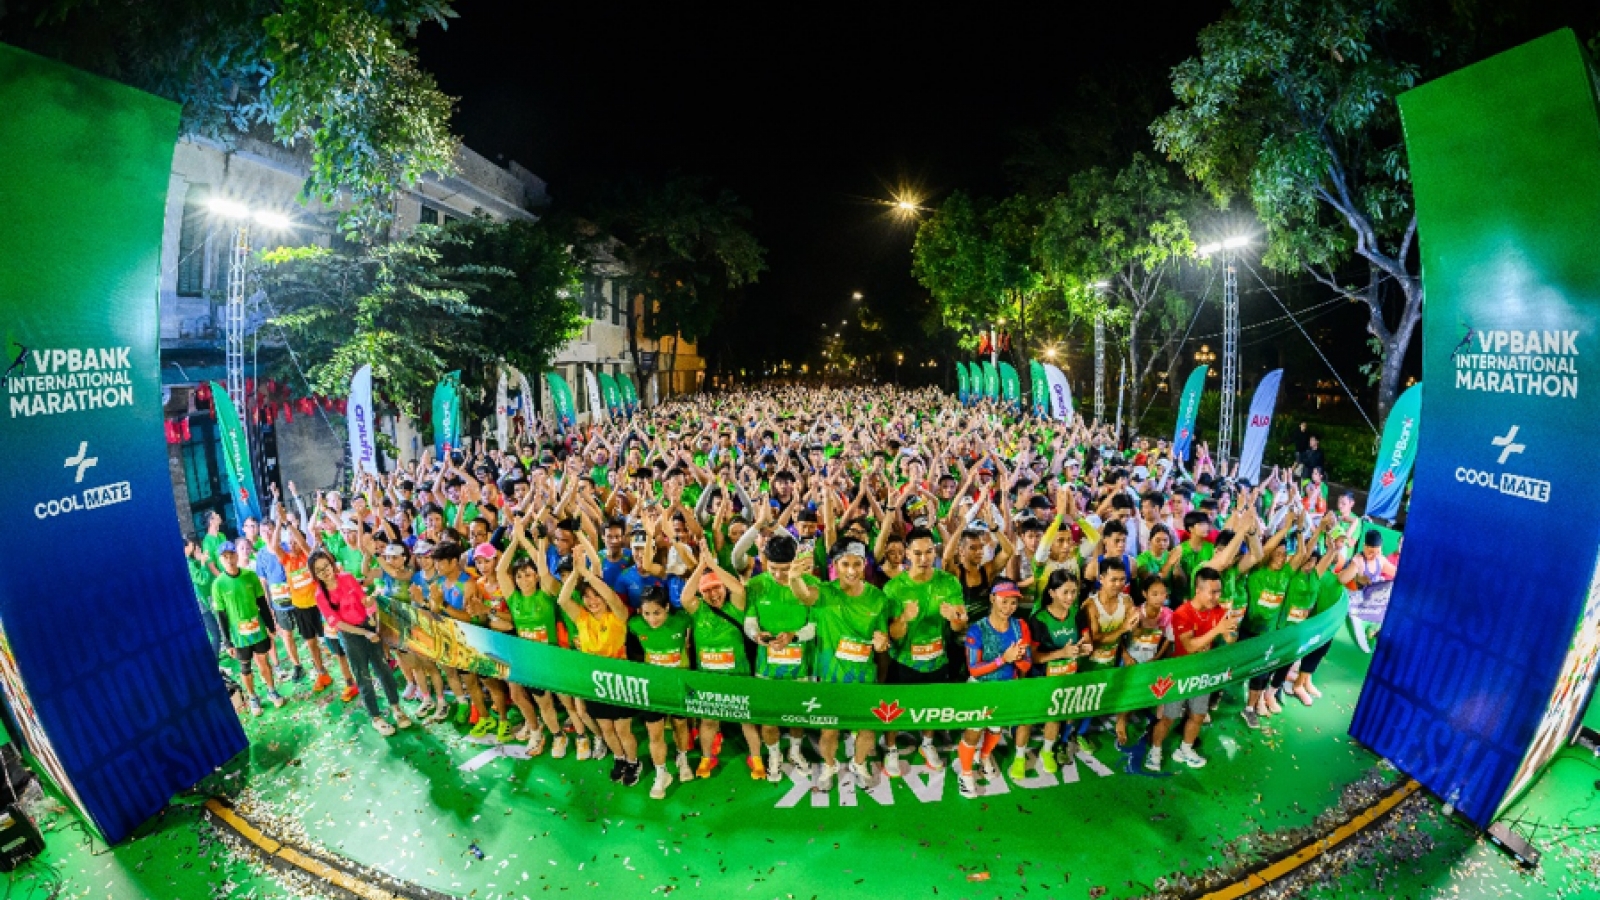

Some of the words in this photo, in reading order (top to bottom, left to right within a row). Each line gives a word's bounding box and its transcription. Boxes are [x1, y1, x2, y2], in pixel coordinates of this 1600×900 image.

[1478, 330, 1579, 355] VPBANK
[32, 346, 131, 373] VPBANK
[1455, 354, 1578, 374] INTERNATIONAL
[8, 370, 132, 394] INTERNATIONAL
[1455, 369, 1578, 399] MARATHON
[10, 385, 133, 418] MARATHON
[1391, 414, 1414, 467] VPBank
[1455, 467, 1499, 490] COOL
[1499, 473, 1551, 503] MATE
[34, 495, 84, 519] COOL
[83, 481, 132, 510] MATE
[592, 670, 649, 707] START
[1177, 668, 1232, 695] VPBank
[697, 690, 750, 704] VPBANK
[1047, 683, 1107, 716] START
[686, 705, 751, 719] MARATHON
[909, 706, 996, 723] VPBank
